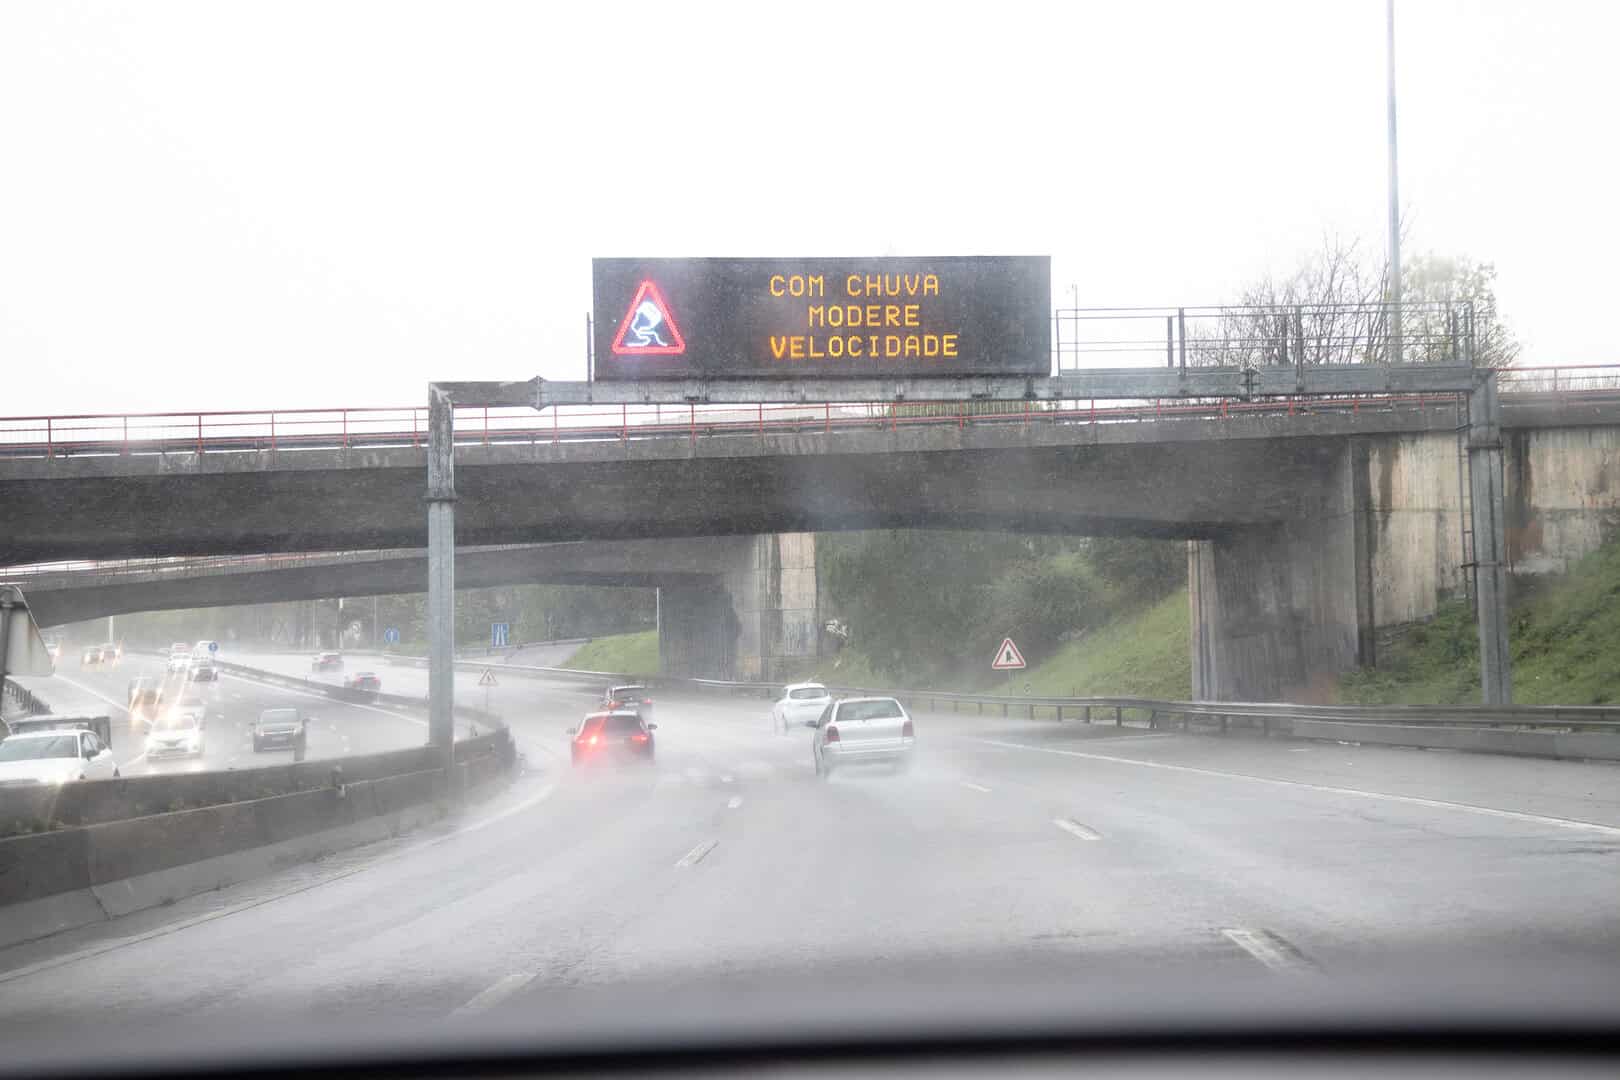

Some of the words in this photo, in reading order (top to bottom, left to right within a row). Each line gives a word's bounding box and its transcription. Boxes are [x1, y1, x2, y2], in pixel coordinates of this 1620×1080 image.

[769, 275, 824, 297] COM
[846, 274, 939, 297] CHUVA
[809, 304, 920, 327] MODERE
[769, 334, 958, 358] VELOCIDADE
